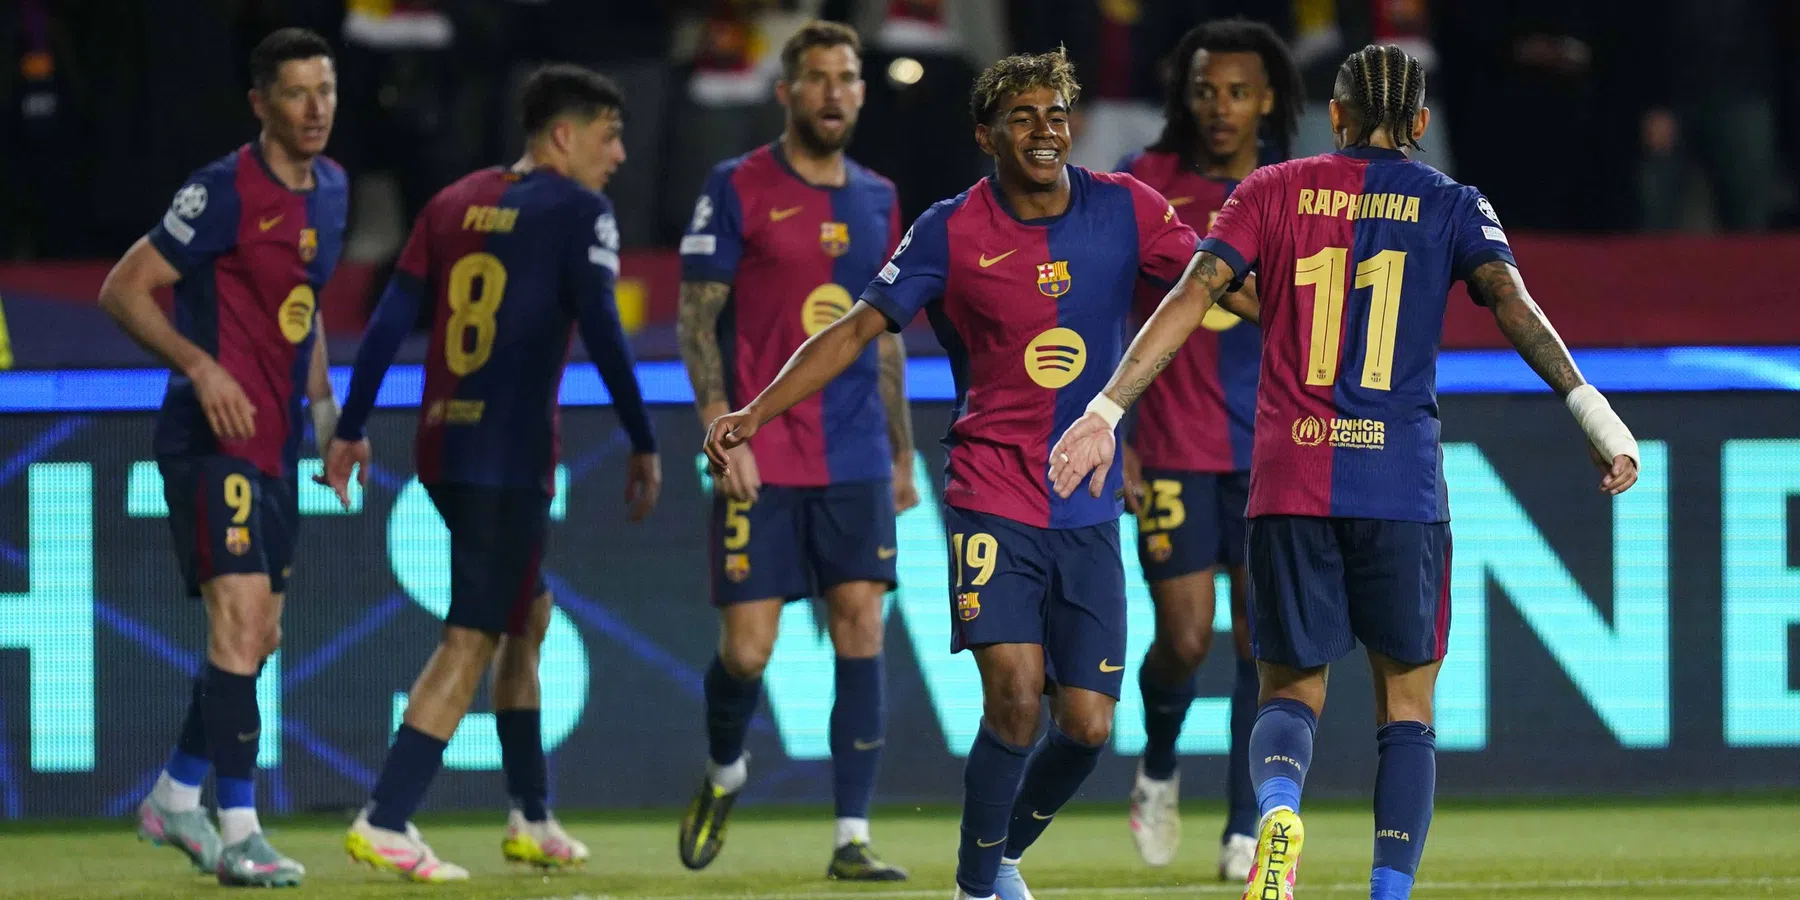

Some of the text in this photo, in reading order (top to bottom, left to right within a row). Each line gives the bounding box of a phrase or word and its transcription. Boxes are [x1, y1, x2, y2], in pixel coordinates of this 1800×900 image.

[462, 205, 520, 231] PEDRI
[1297, 188, 1421, 222] RAPHINHA
[445, 252, 508, 376] 8
[1294, 246, 1408, 391] 11
[1328, 431, 1385, 445] ACNUR
[1330, 418, 1385, 432] UNHCR
[223, 472, 252, 525] 9
[724, 499, 752, 550] 5
[1138, 479, 1186, 532] 23
[953, 532, 998, 587] 19
